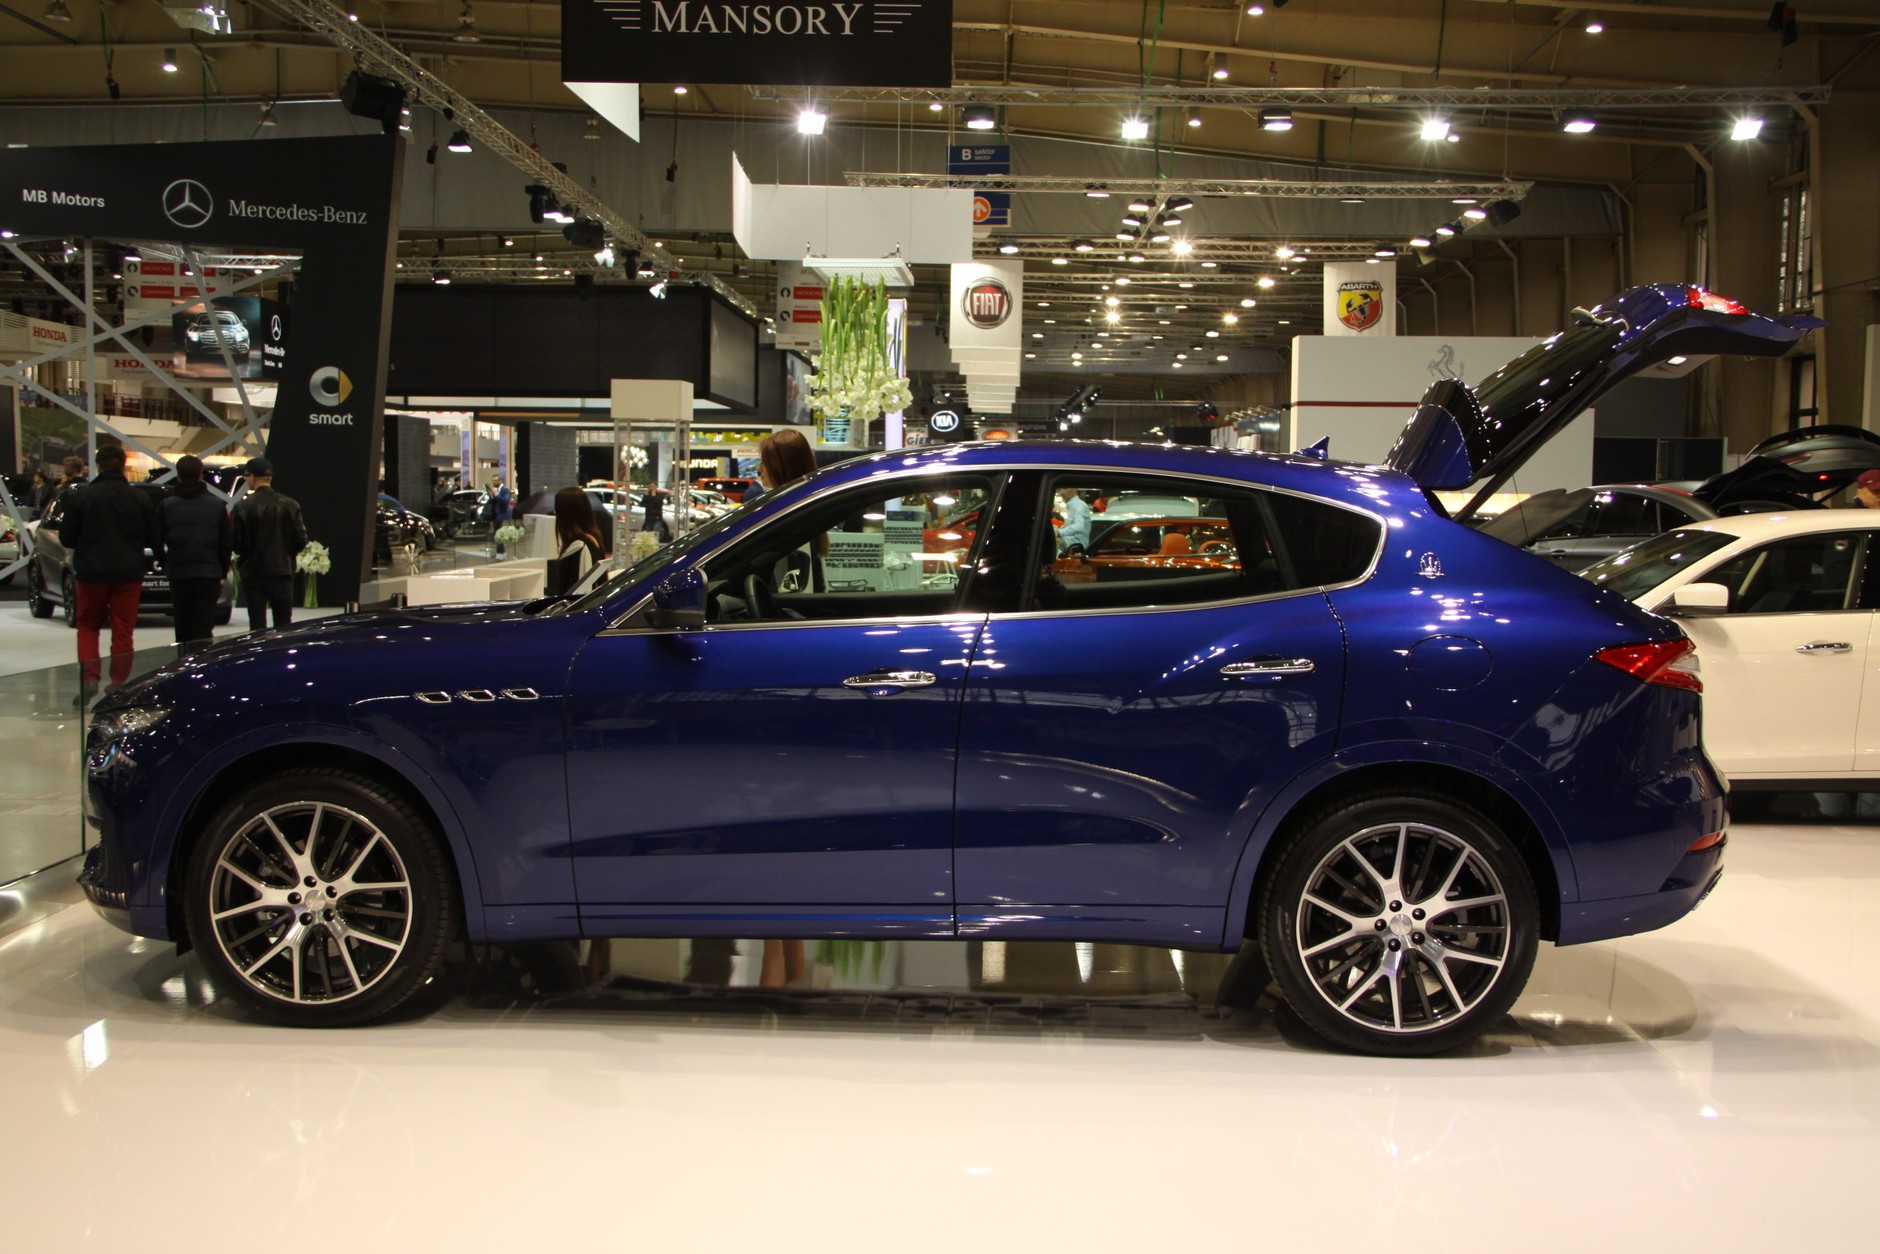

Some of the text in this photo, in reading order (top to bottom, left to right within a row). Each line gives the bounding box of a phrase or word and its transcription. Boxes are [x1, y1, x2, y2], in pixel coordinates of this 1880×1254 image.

[651, 1, 864, 36] MANSORY
[962, 148, 972, 160] B
[22, 188, 105, 208] MB Motors
[228, 199, 368, 225] Mercedes-Benz
[972, 292, 1002, 316] FIAT
[32, 326, 68, 342] HONDA
[309, 413, 353, 425] smart
[935, 414, 953, 428] KIA
